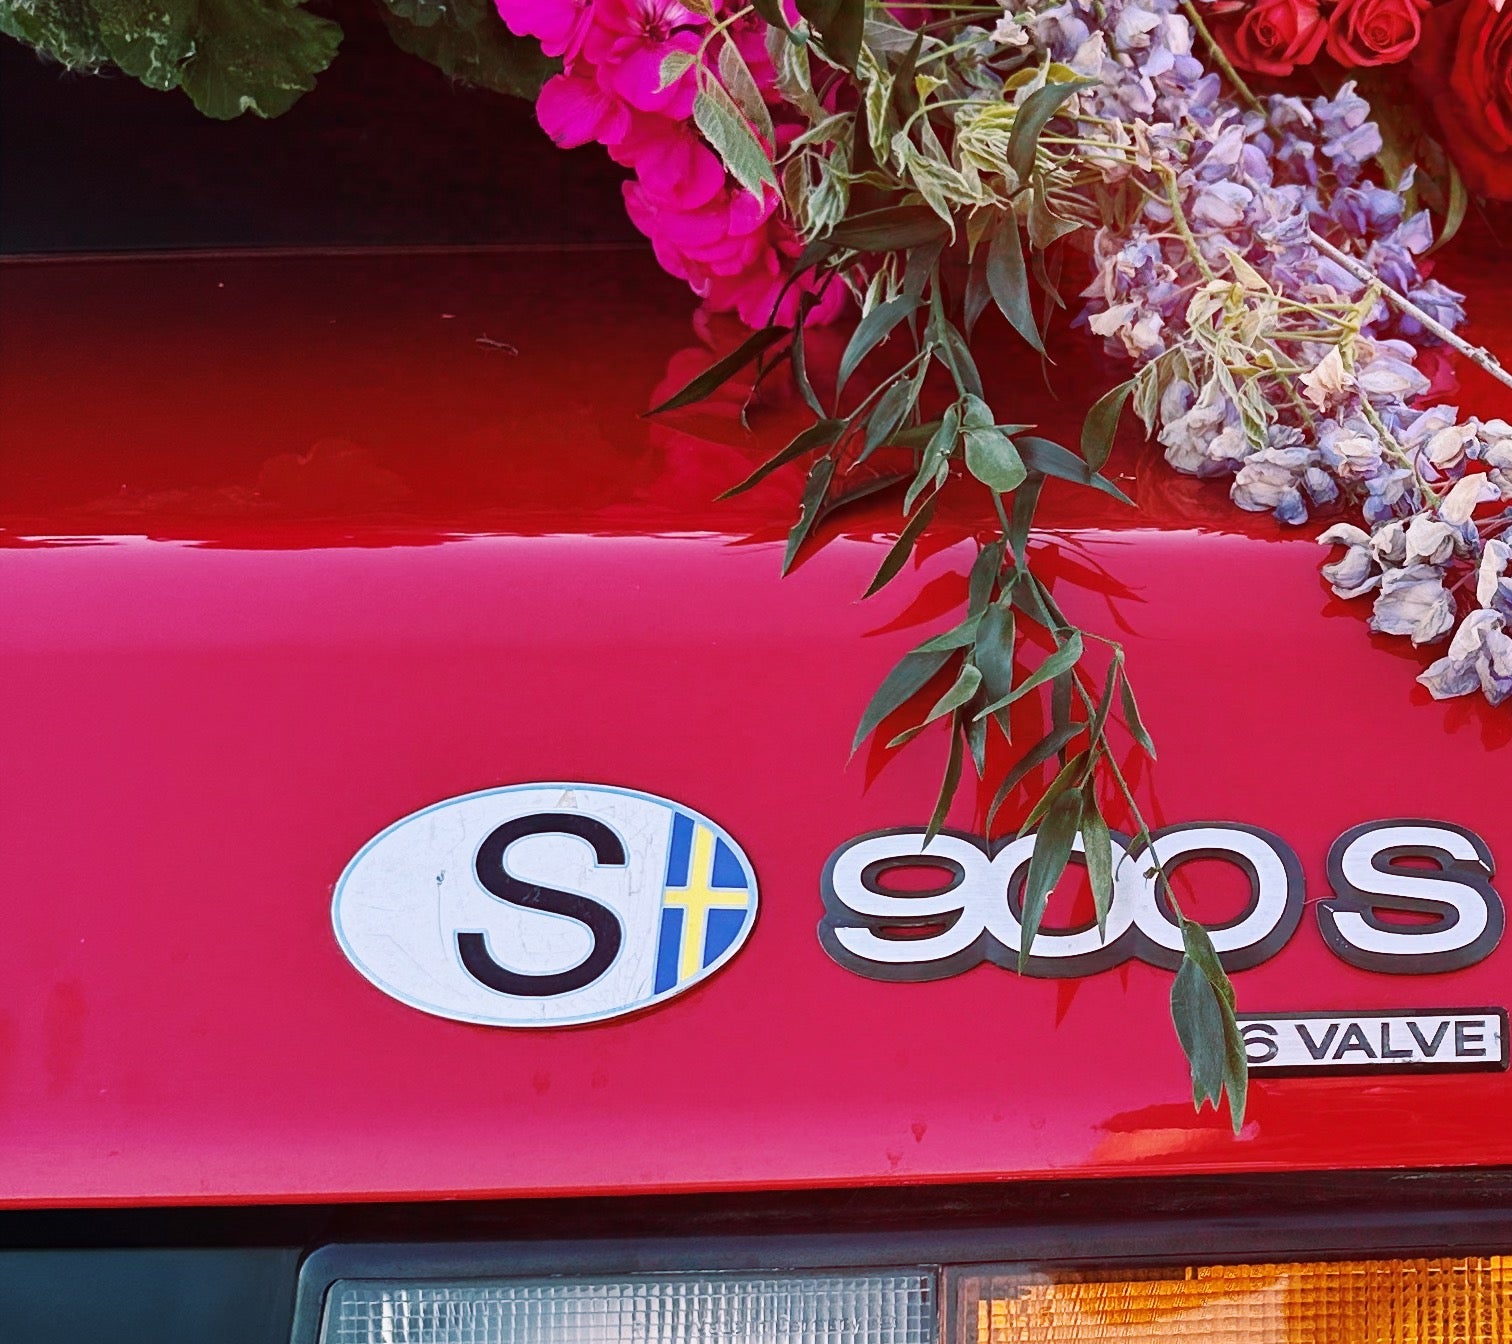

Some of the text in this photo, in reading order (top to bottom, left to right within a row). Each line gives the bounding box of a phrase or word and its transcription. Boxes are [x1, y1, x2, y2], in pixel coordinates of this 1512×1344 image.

[456, 811, 627, 997] S
[832, 826, 1489, 964] 900 S
[1240, 1019, 1488, 1064] 6 VALVE
